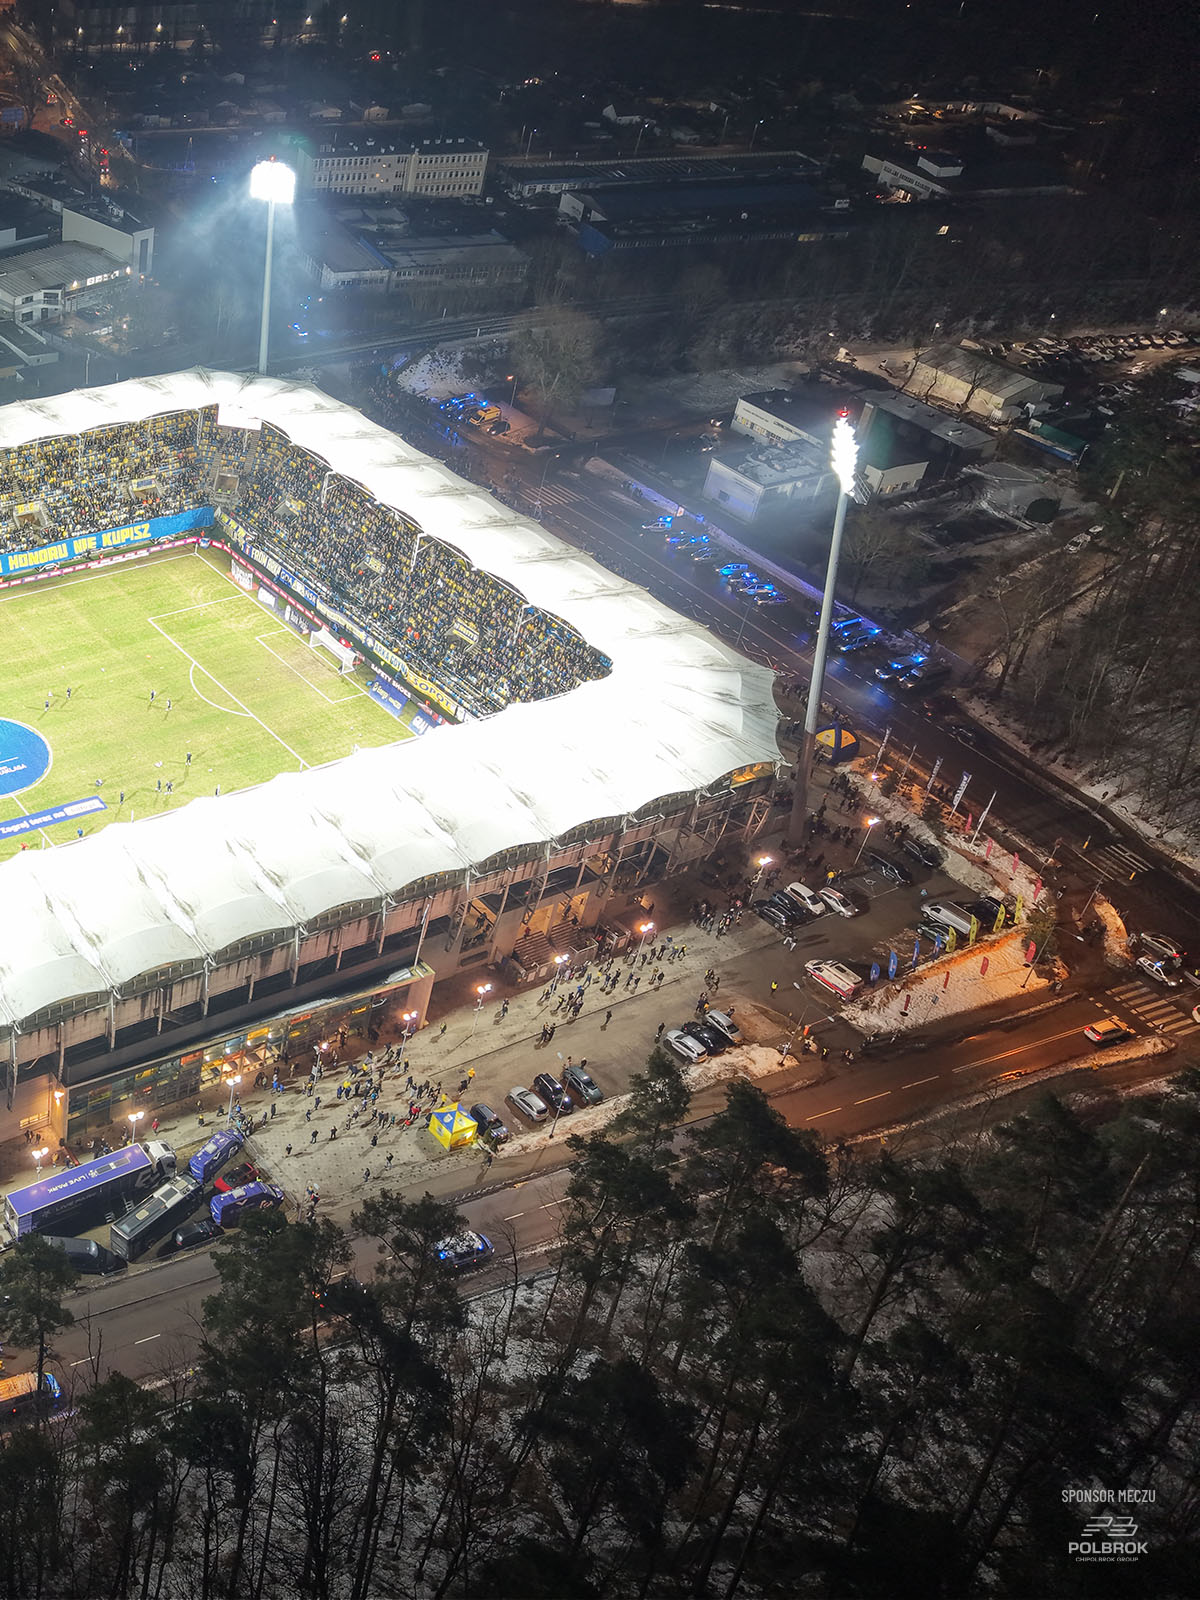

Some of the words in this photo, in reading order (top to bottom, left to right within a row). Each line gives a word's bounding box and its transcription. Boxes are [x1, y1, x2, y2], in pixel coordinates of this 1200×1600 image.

[8, 543, 69, 571] HONORU
[73, 536, 97, 555] NIE
[101, 523, 152, 547] KUPISZ
